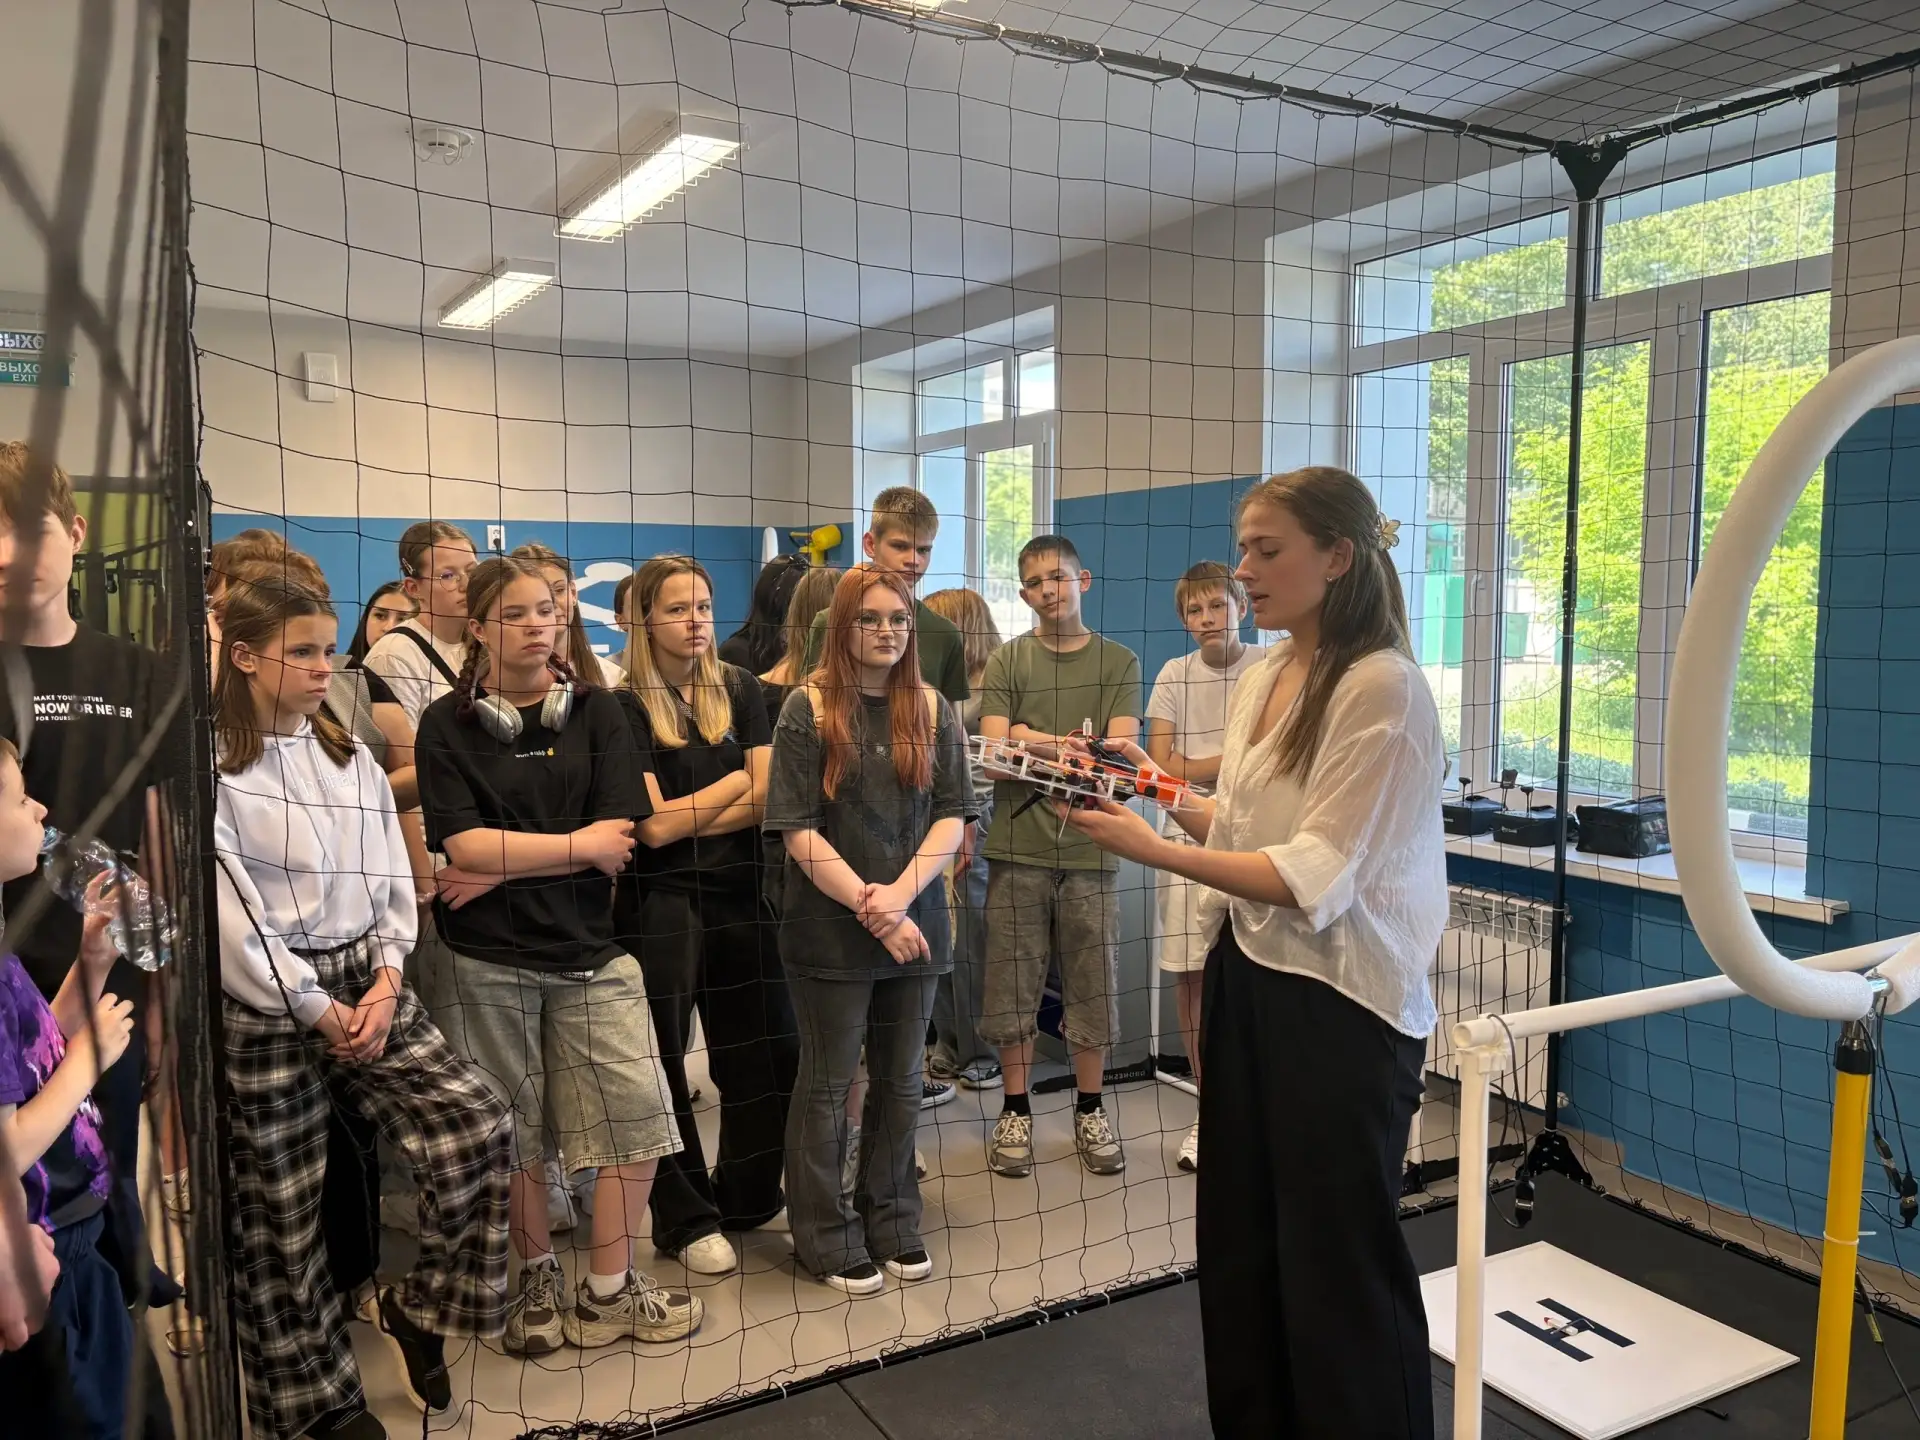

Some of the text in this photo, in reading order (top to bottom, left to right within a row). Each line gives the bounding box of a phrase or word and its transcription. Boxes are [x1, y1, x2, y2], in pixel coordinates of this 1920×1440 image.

[0, 333, 45, 349] ЫХО
[0, 362, 41, 373] ВЫХО
[12, 374, 37, 382] EXIT
[33, 694, 55, 702] MAKE
[79, 695, 103, 703] UTURE
[34, 702, 70, 715] NOW
[74, 703, 94, 714] OR
[1494, 1298, 1637, 1362] H
